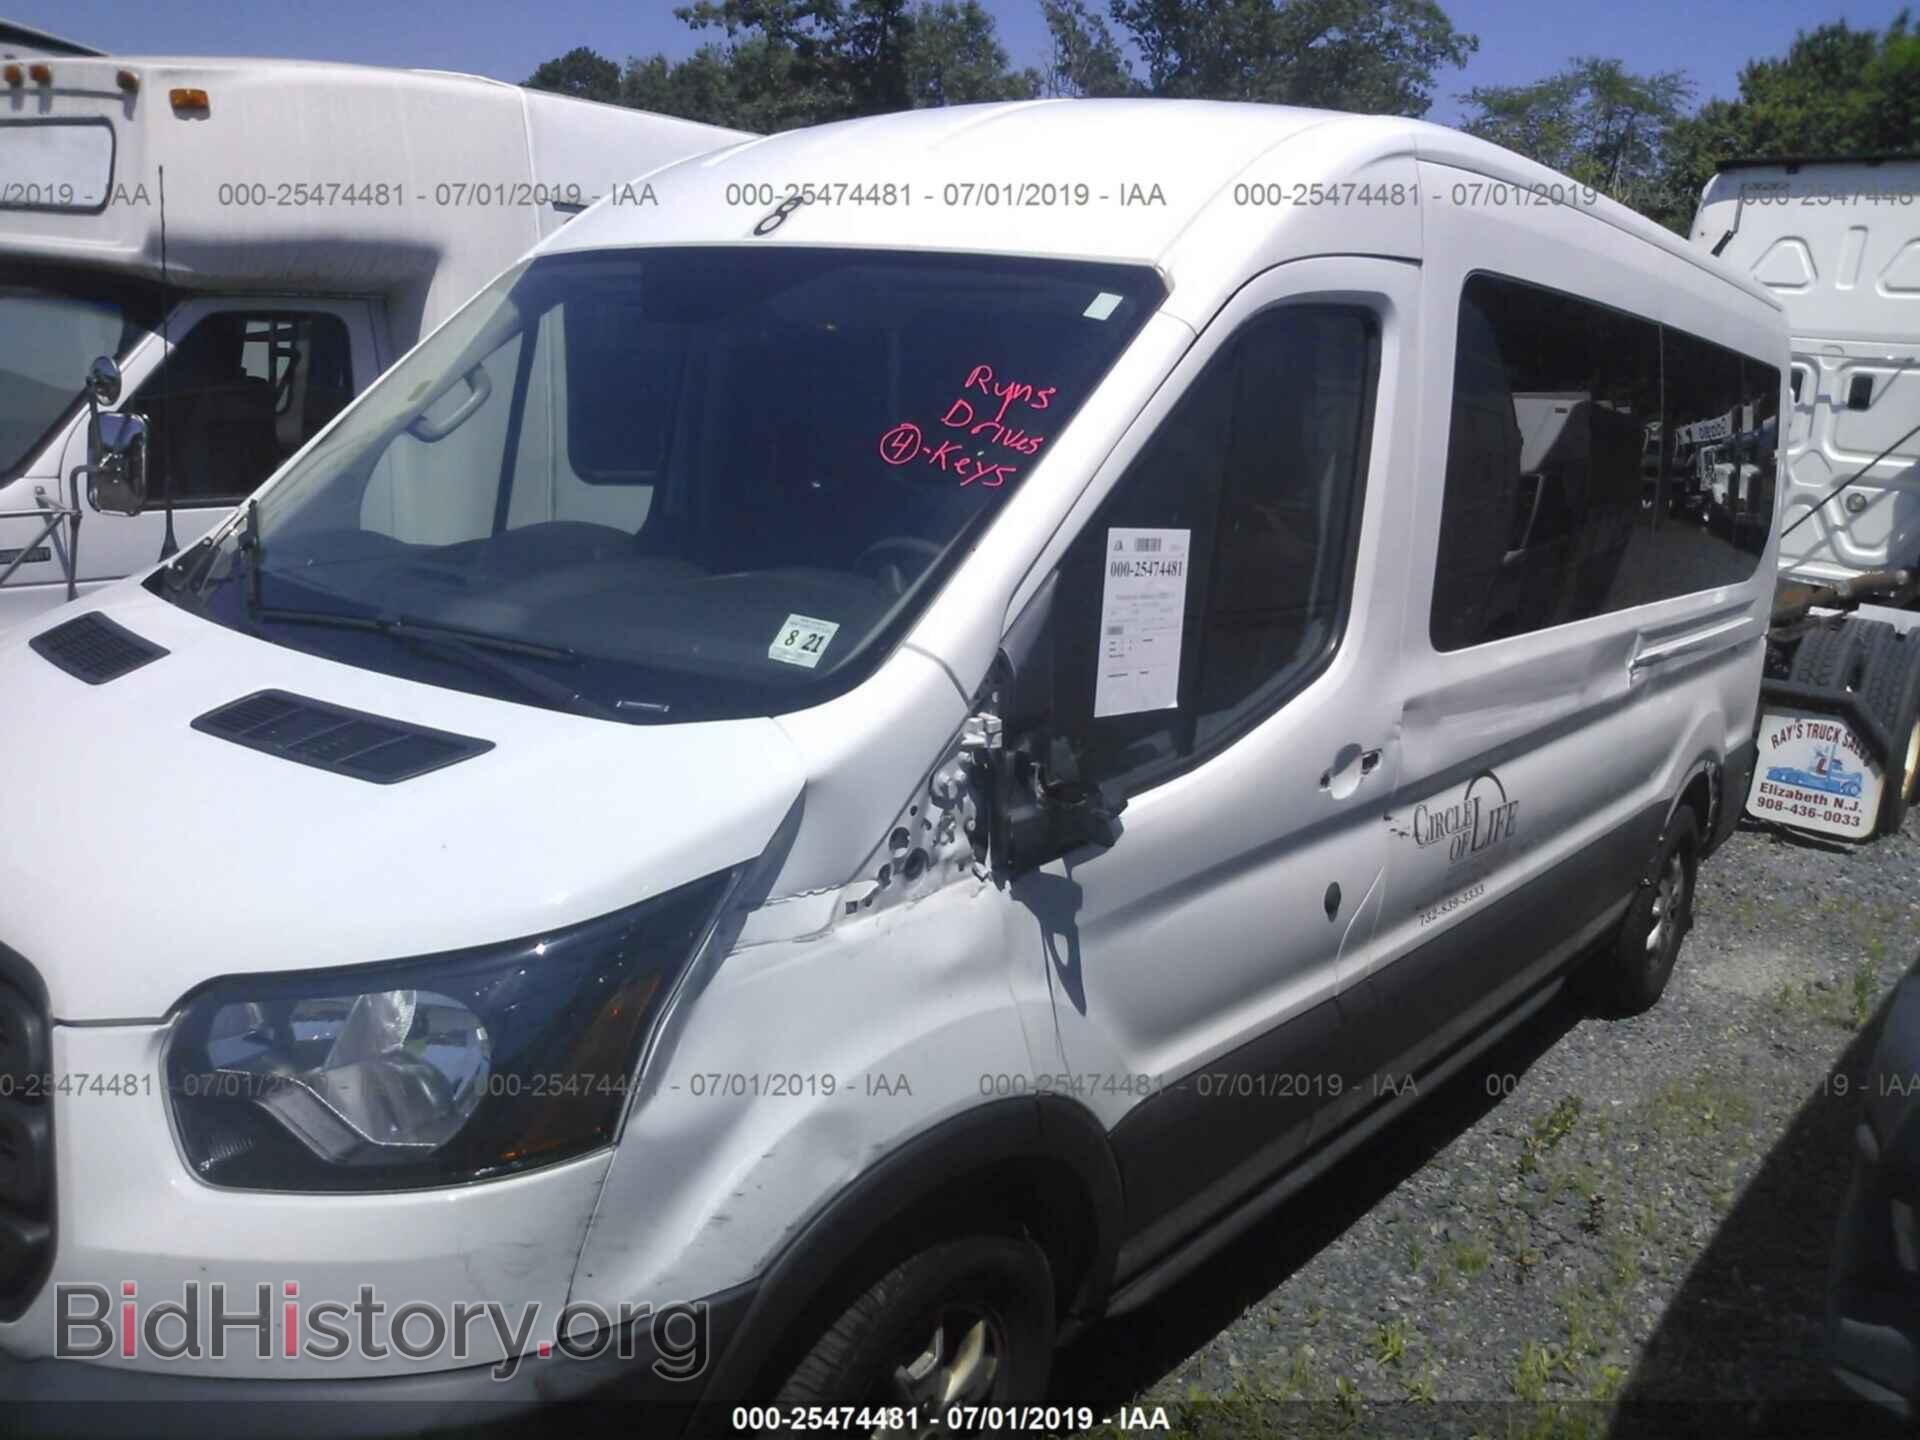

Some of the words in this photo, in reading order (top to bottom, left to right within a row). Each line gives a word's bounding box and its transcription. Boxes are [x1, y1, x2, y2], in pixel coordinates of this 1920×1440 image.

[753, 196, 804, 236] 8
[1110, 560, 1183, 578] 000-25474481
[784, 629, 800, 647] 8
[801, 632, 825, 654] 21
[1770, 723, 1803, 750] RAY'S
[1807, 723, 1841, 744] TRUCK
[1757, 797, 1861, 828] 908-436-0033
[1760, 781, 1828, 806] Elizabeth
[1833, 797, 1863, 813] N.J.
[1413, 803, 1473, 849] CIRCLE
[1449, 829, 1473, 863] OF
[1471, 796, 1520, 852] LIFE
